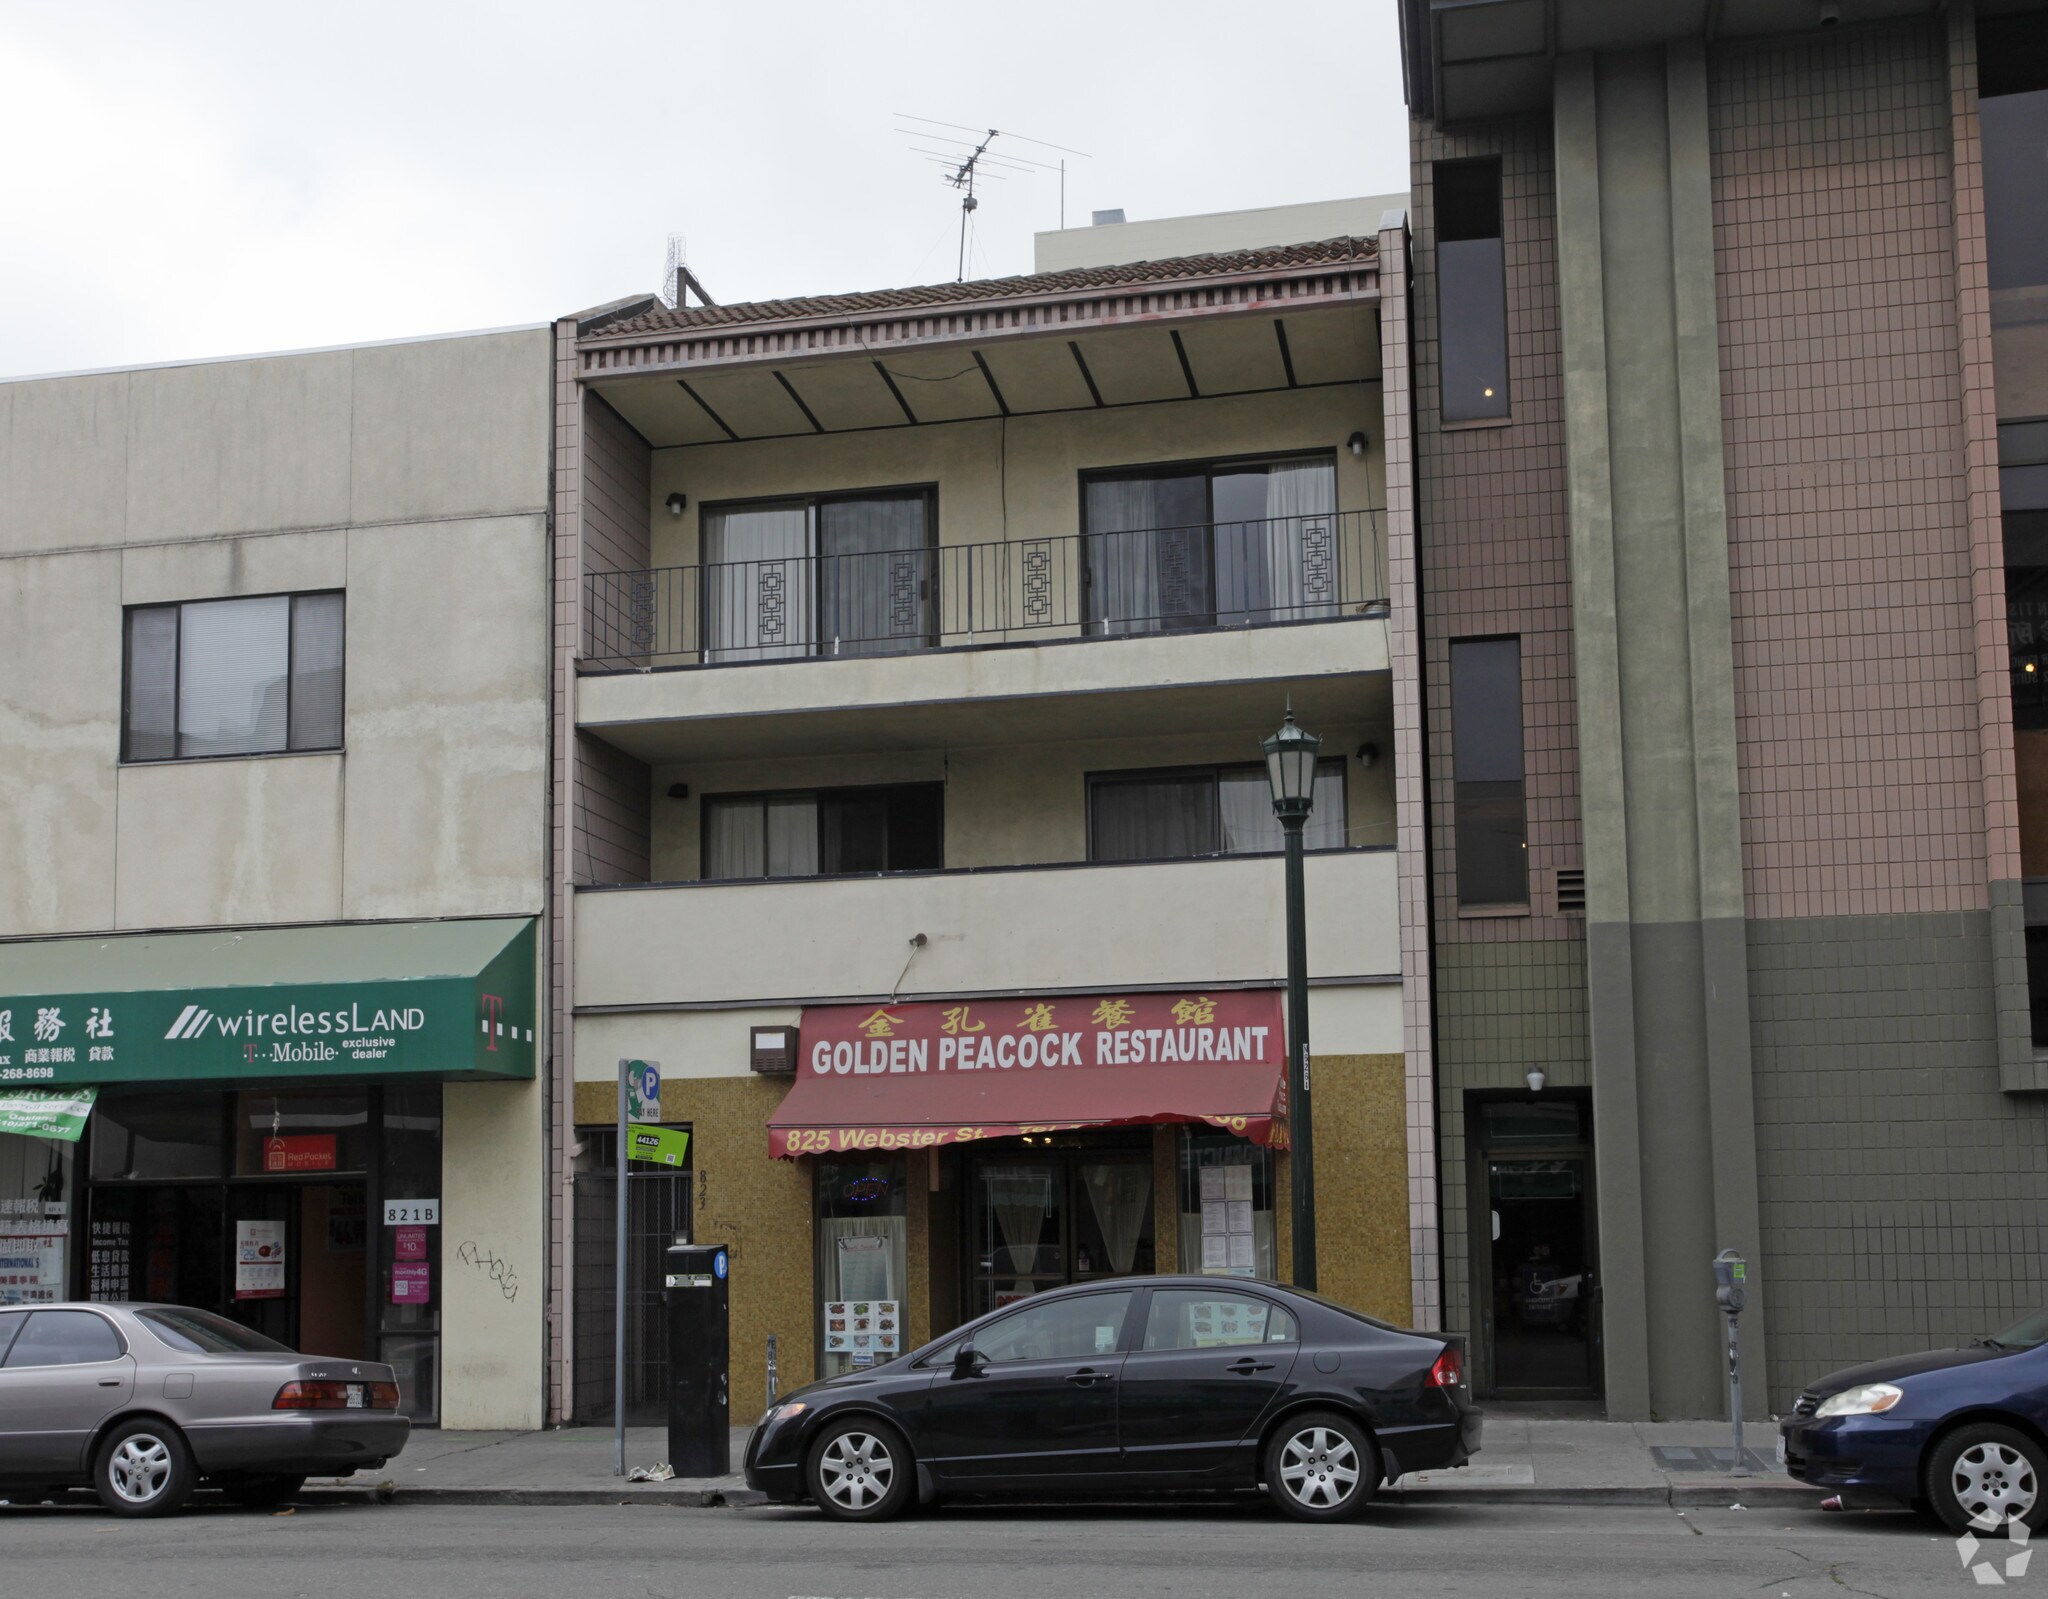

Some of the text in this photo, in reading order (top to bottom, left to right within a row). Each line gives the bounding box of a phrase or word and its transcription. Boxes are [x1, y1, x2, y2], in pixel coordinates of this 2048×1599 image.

[342, 1036, 396, 1049] exclusive
[88, 1045, 115, 1062] 貸款
[352, 1048, 388, 1060] dealer
[812, 1027, 1268, 1075] GOLDEN PEACOCK RESTAURANT
[645, 1072, 657, 1096] P
[8, 1112, 57, 1122] Oakland
[646, 1107, 659, 1118] HERE
[637, 1135, 659, 1146] 44126
[786, 1129, 831, 1151] 825
[838, 1128, 948, 1149] Webster
[954, 1126, 988, 1142] St.
[288, 1153, 303, 1161] Red
[305, 1152, 332, 1161] Pocket
[92, 1237, 129, 1246] Income Tax
[403, 1241, 417, 1252] $10
